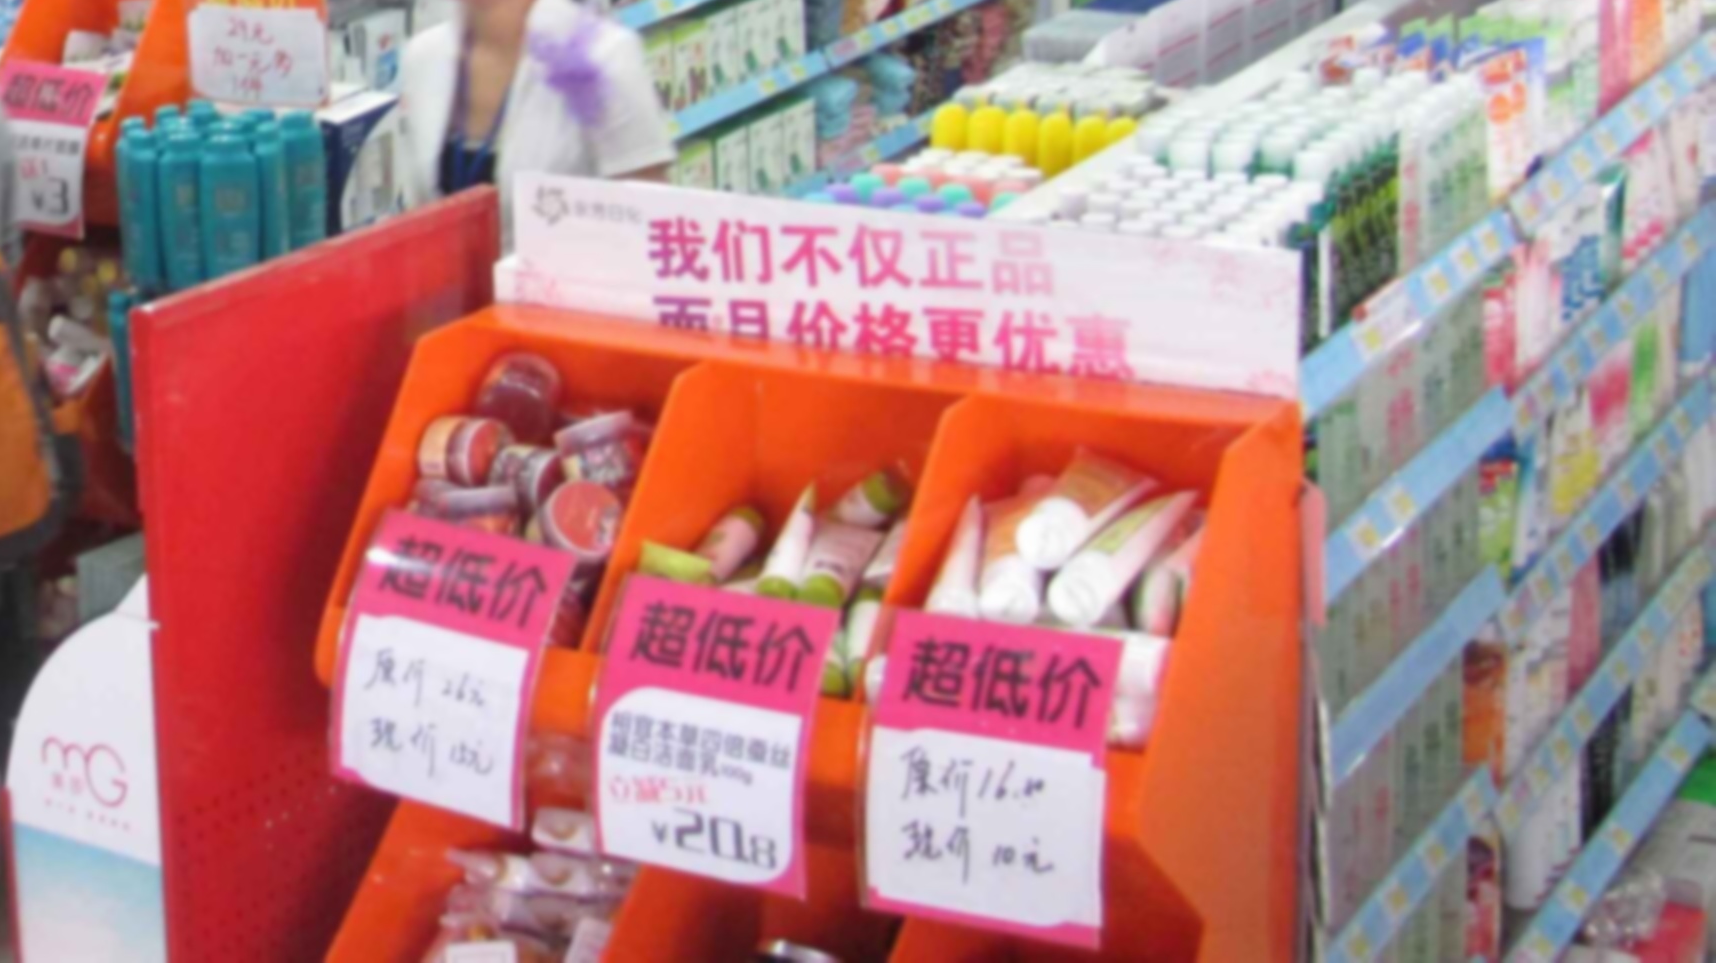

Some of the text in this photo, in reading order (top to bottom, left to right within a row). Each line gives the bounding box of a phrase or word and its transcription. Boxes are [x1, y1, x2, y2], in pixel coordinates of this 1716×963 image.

[3, 72, 95, 119] 超低价
[647, 216, 1055, 297] 我们不仅正品
[652, 294, 1136, 382] 而且价格更优惠
[378, 534, 547, 629] 超低价
[629, 599, 815, 696] 超低价
[901, 636, 1102, 730] 超低价
